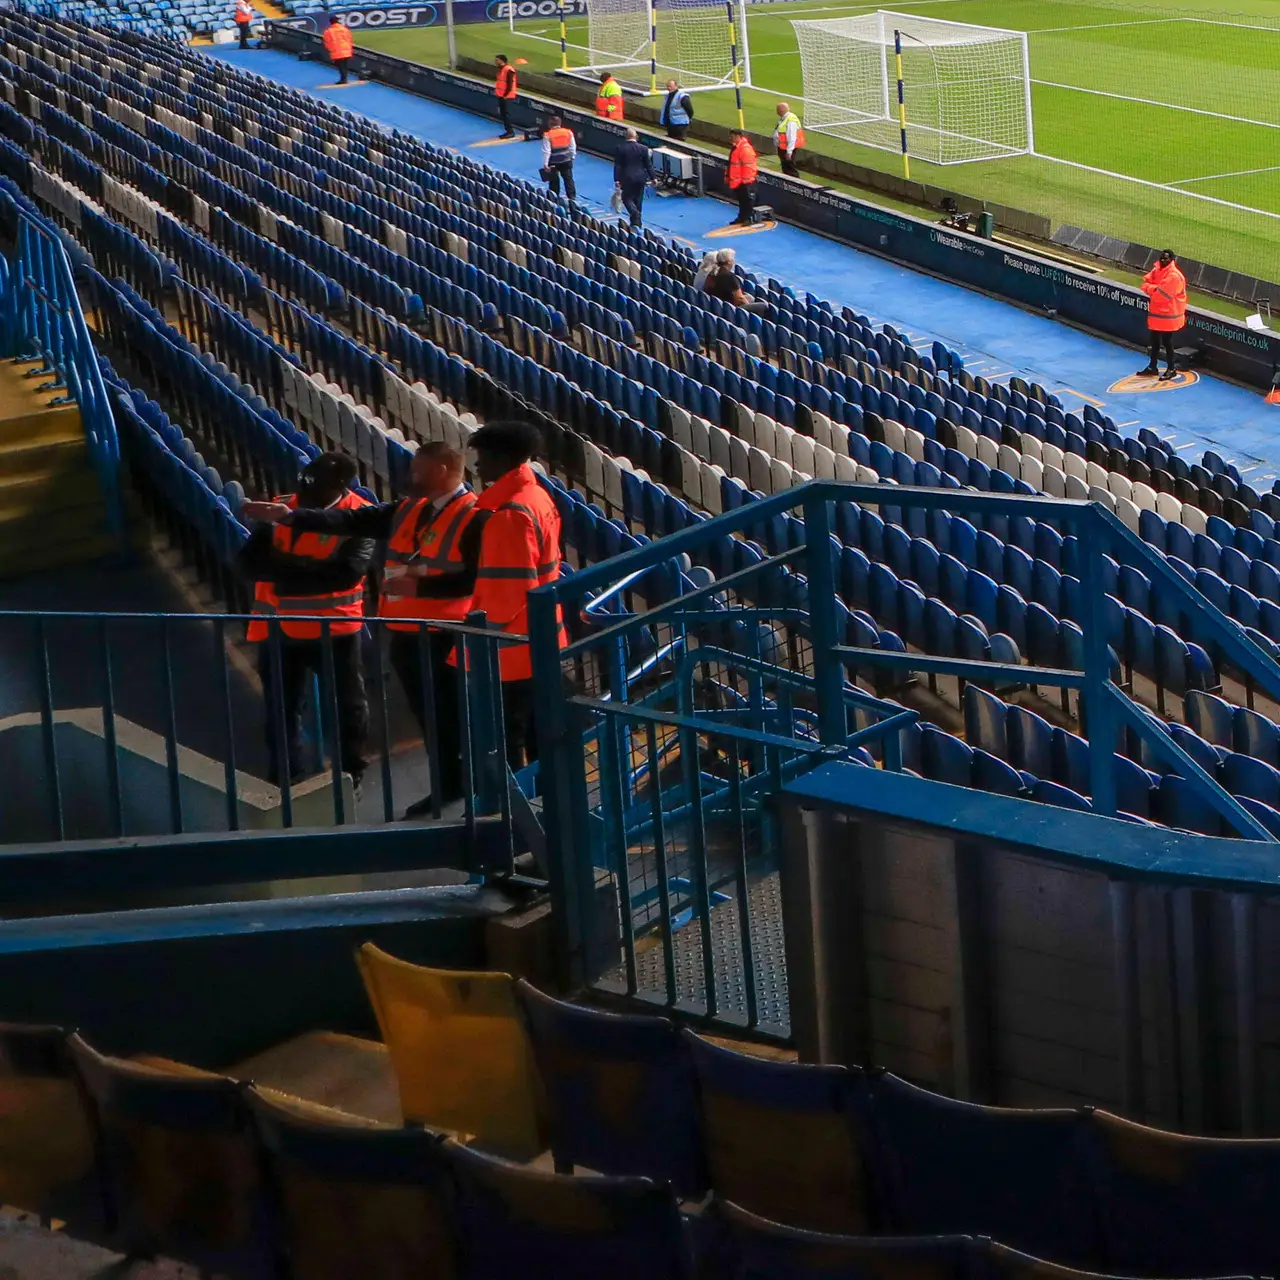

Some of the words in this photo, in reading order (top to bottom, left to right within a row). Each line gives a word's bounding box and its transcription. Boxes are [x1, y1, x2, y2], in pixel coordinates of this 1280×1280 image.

[1004, 254, 1023, 270] Please
[1024, 262, 1040, 277] quote
[1065, 274, 1072, 287] to
[1073, 278, 1096, 295] receive
[1097, 282, 1110, 299] 10%
[1110, 289, 1120, 302] off
[1120, 292, 1136, 307] your
[1188, 317, 1269, 351] w.wearableprint.co.uk
